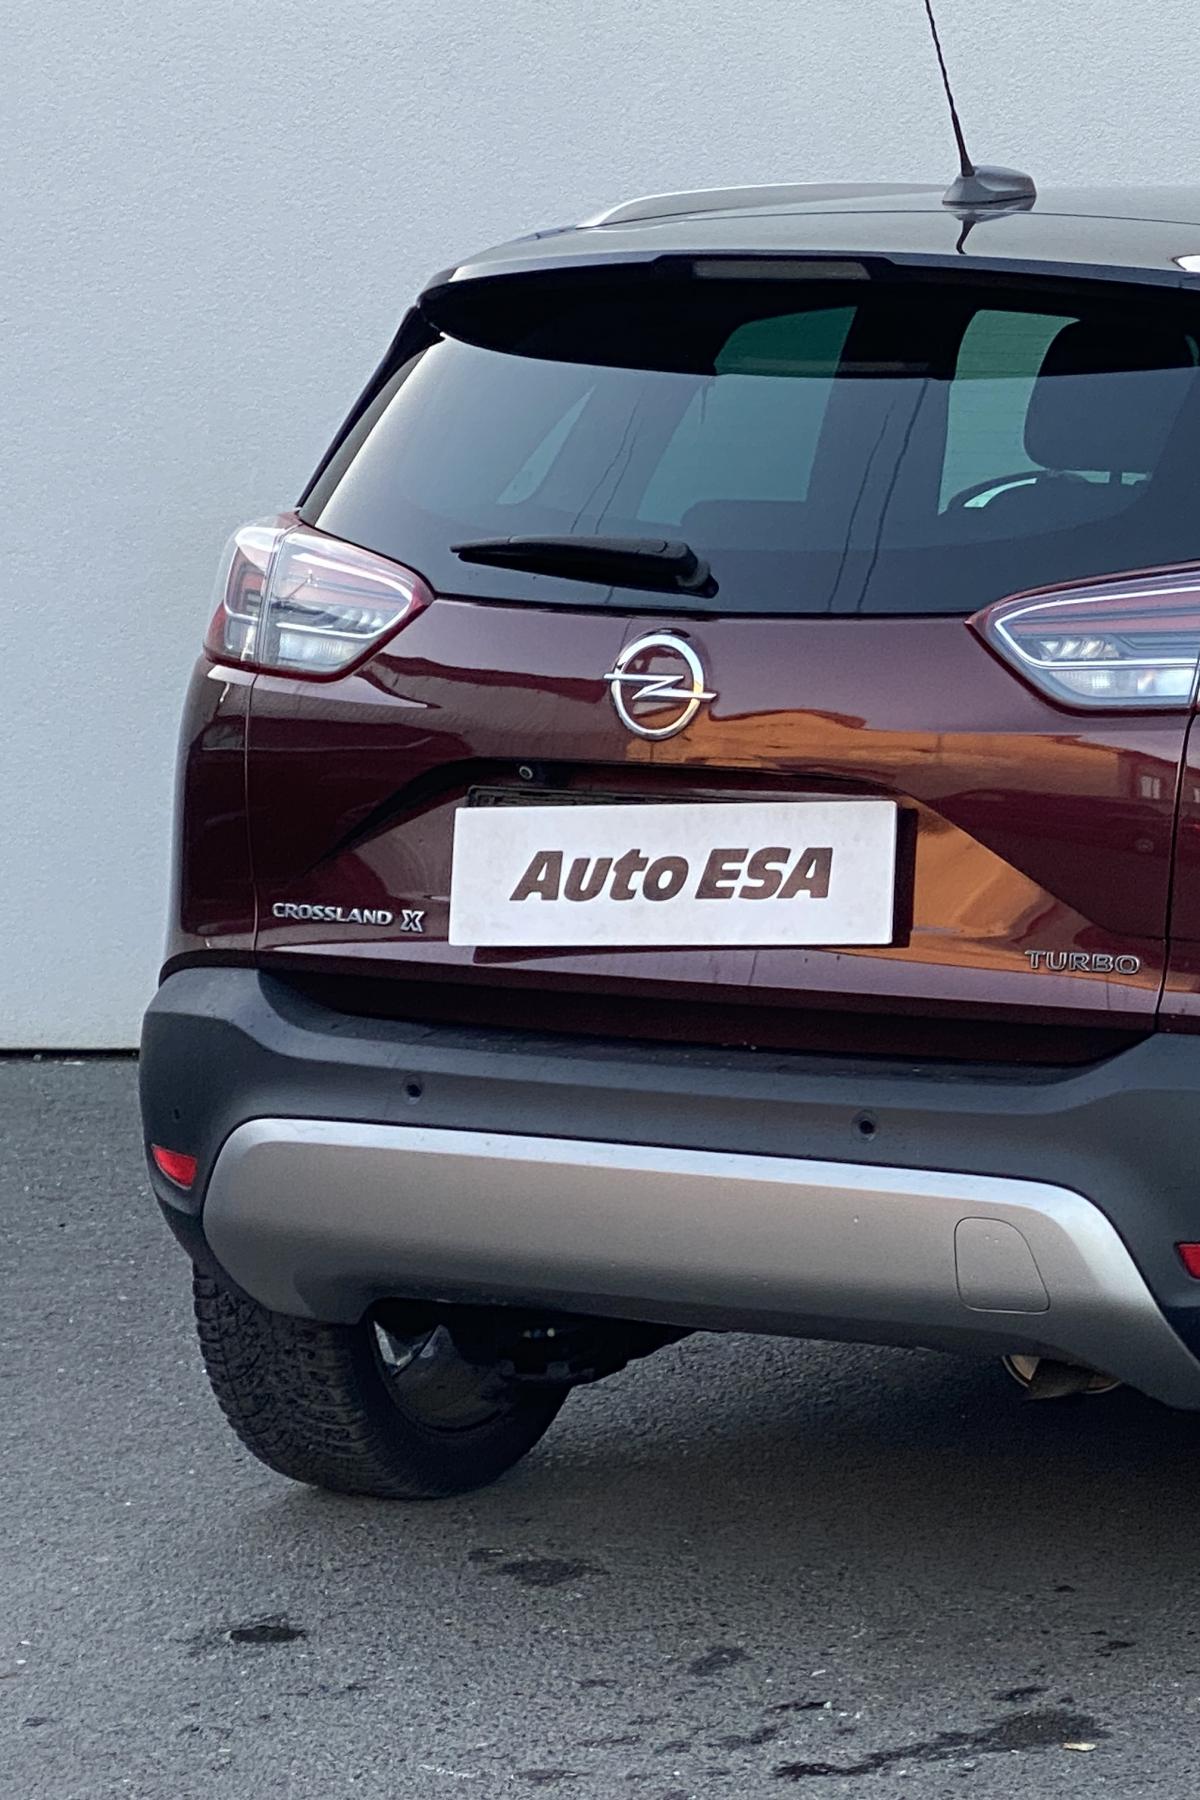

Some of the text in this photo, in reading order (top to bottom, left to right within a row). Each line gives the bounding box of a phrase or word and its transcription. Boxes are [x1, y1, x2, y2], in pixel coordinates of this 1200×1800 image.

[509, 846, 834, 901] Auto ESA
[272, 902, 425, 933] CROSSLAND X
[1024, 949, 1140, 975] TURBO
